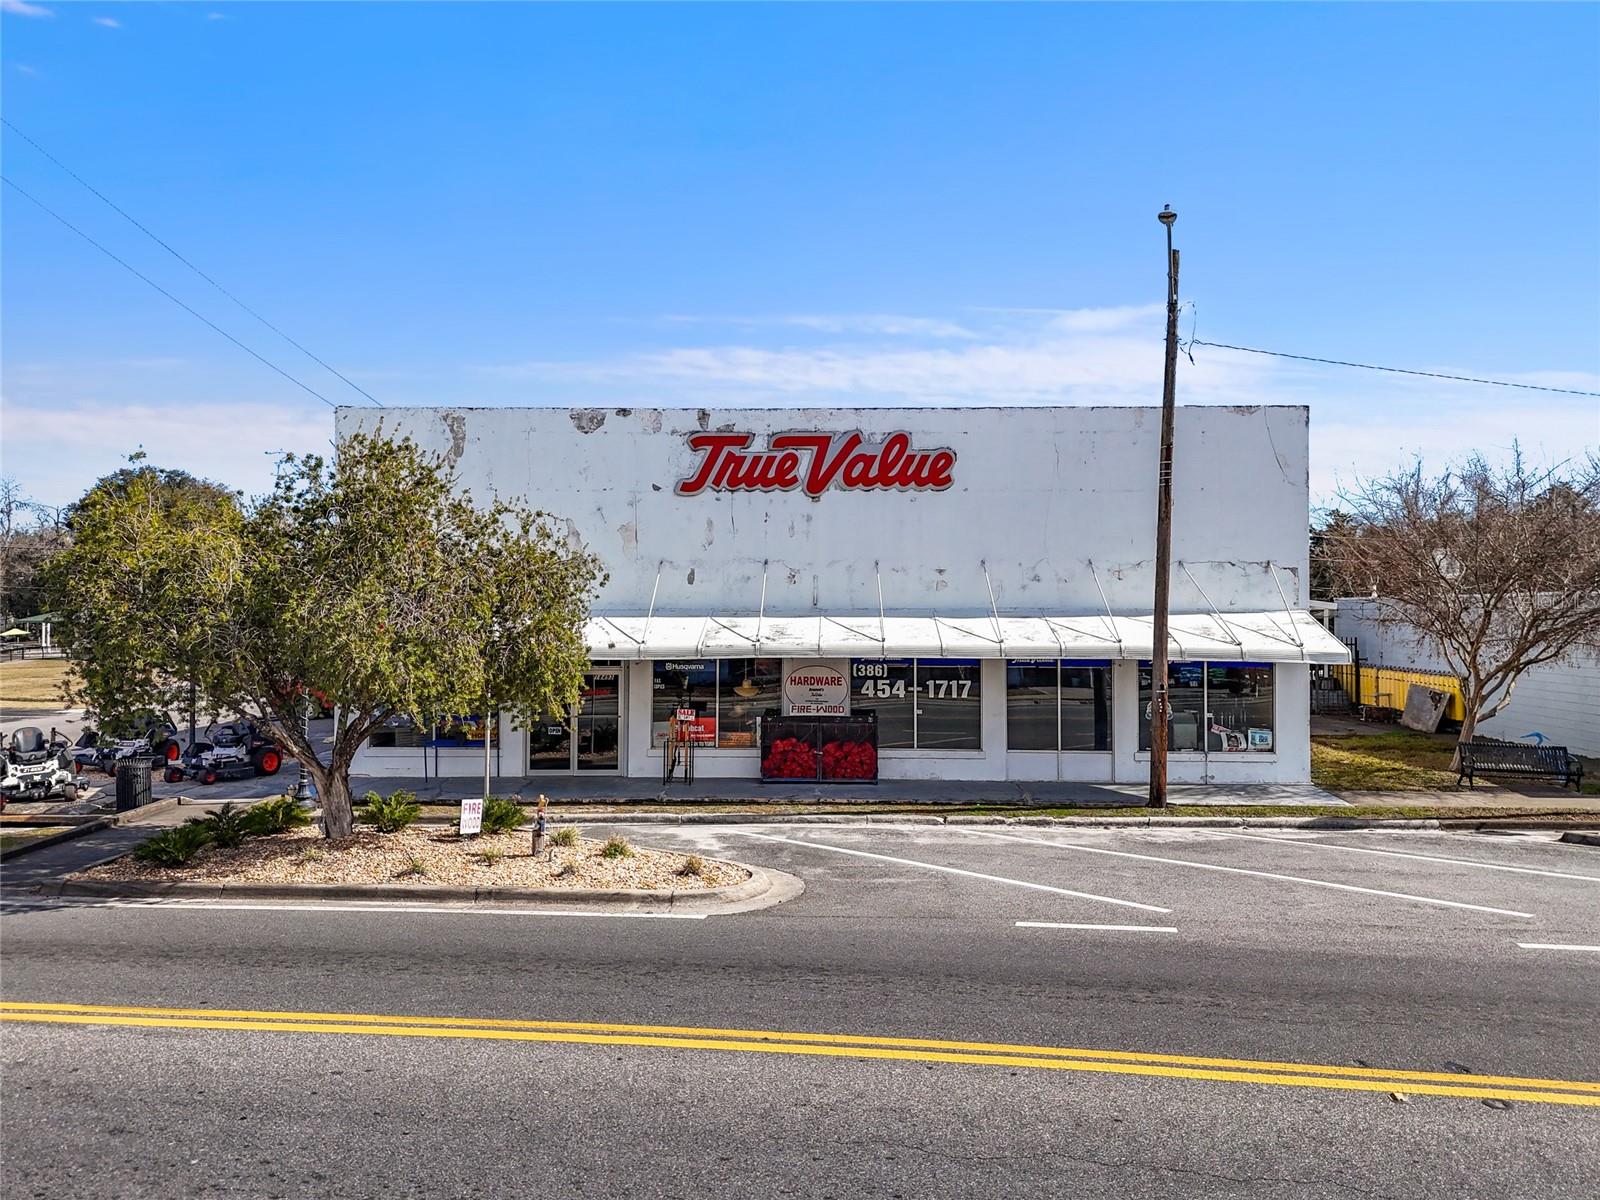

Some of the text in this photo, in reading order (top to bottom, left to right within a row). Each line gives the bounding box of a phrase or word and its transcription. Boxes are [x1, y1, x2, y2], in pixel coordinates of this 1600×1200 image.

[677, 430, 955, 496] True Value
[852, 663, 888, 677] (386)
[790, 676, 843, 686] HARDWARE
[861, 680, 972, 698] 454-1717
[791, 705, 845, 713] FIRE-WOOD
[463, 802, 481, 814] FIRE
